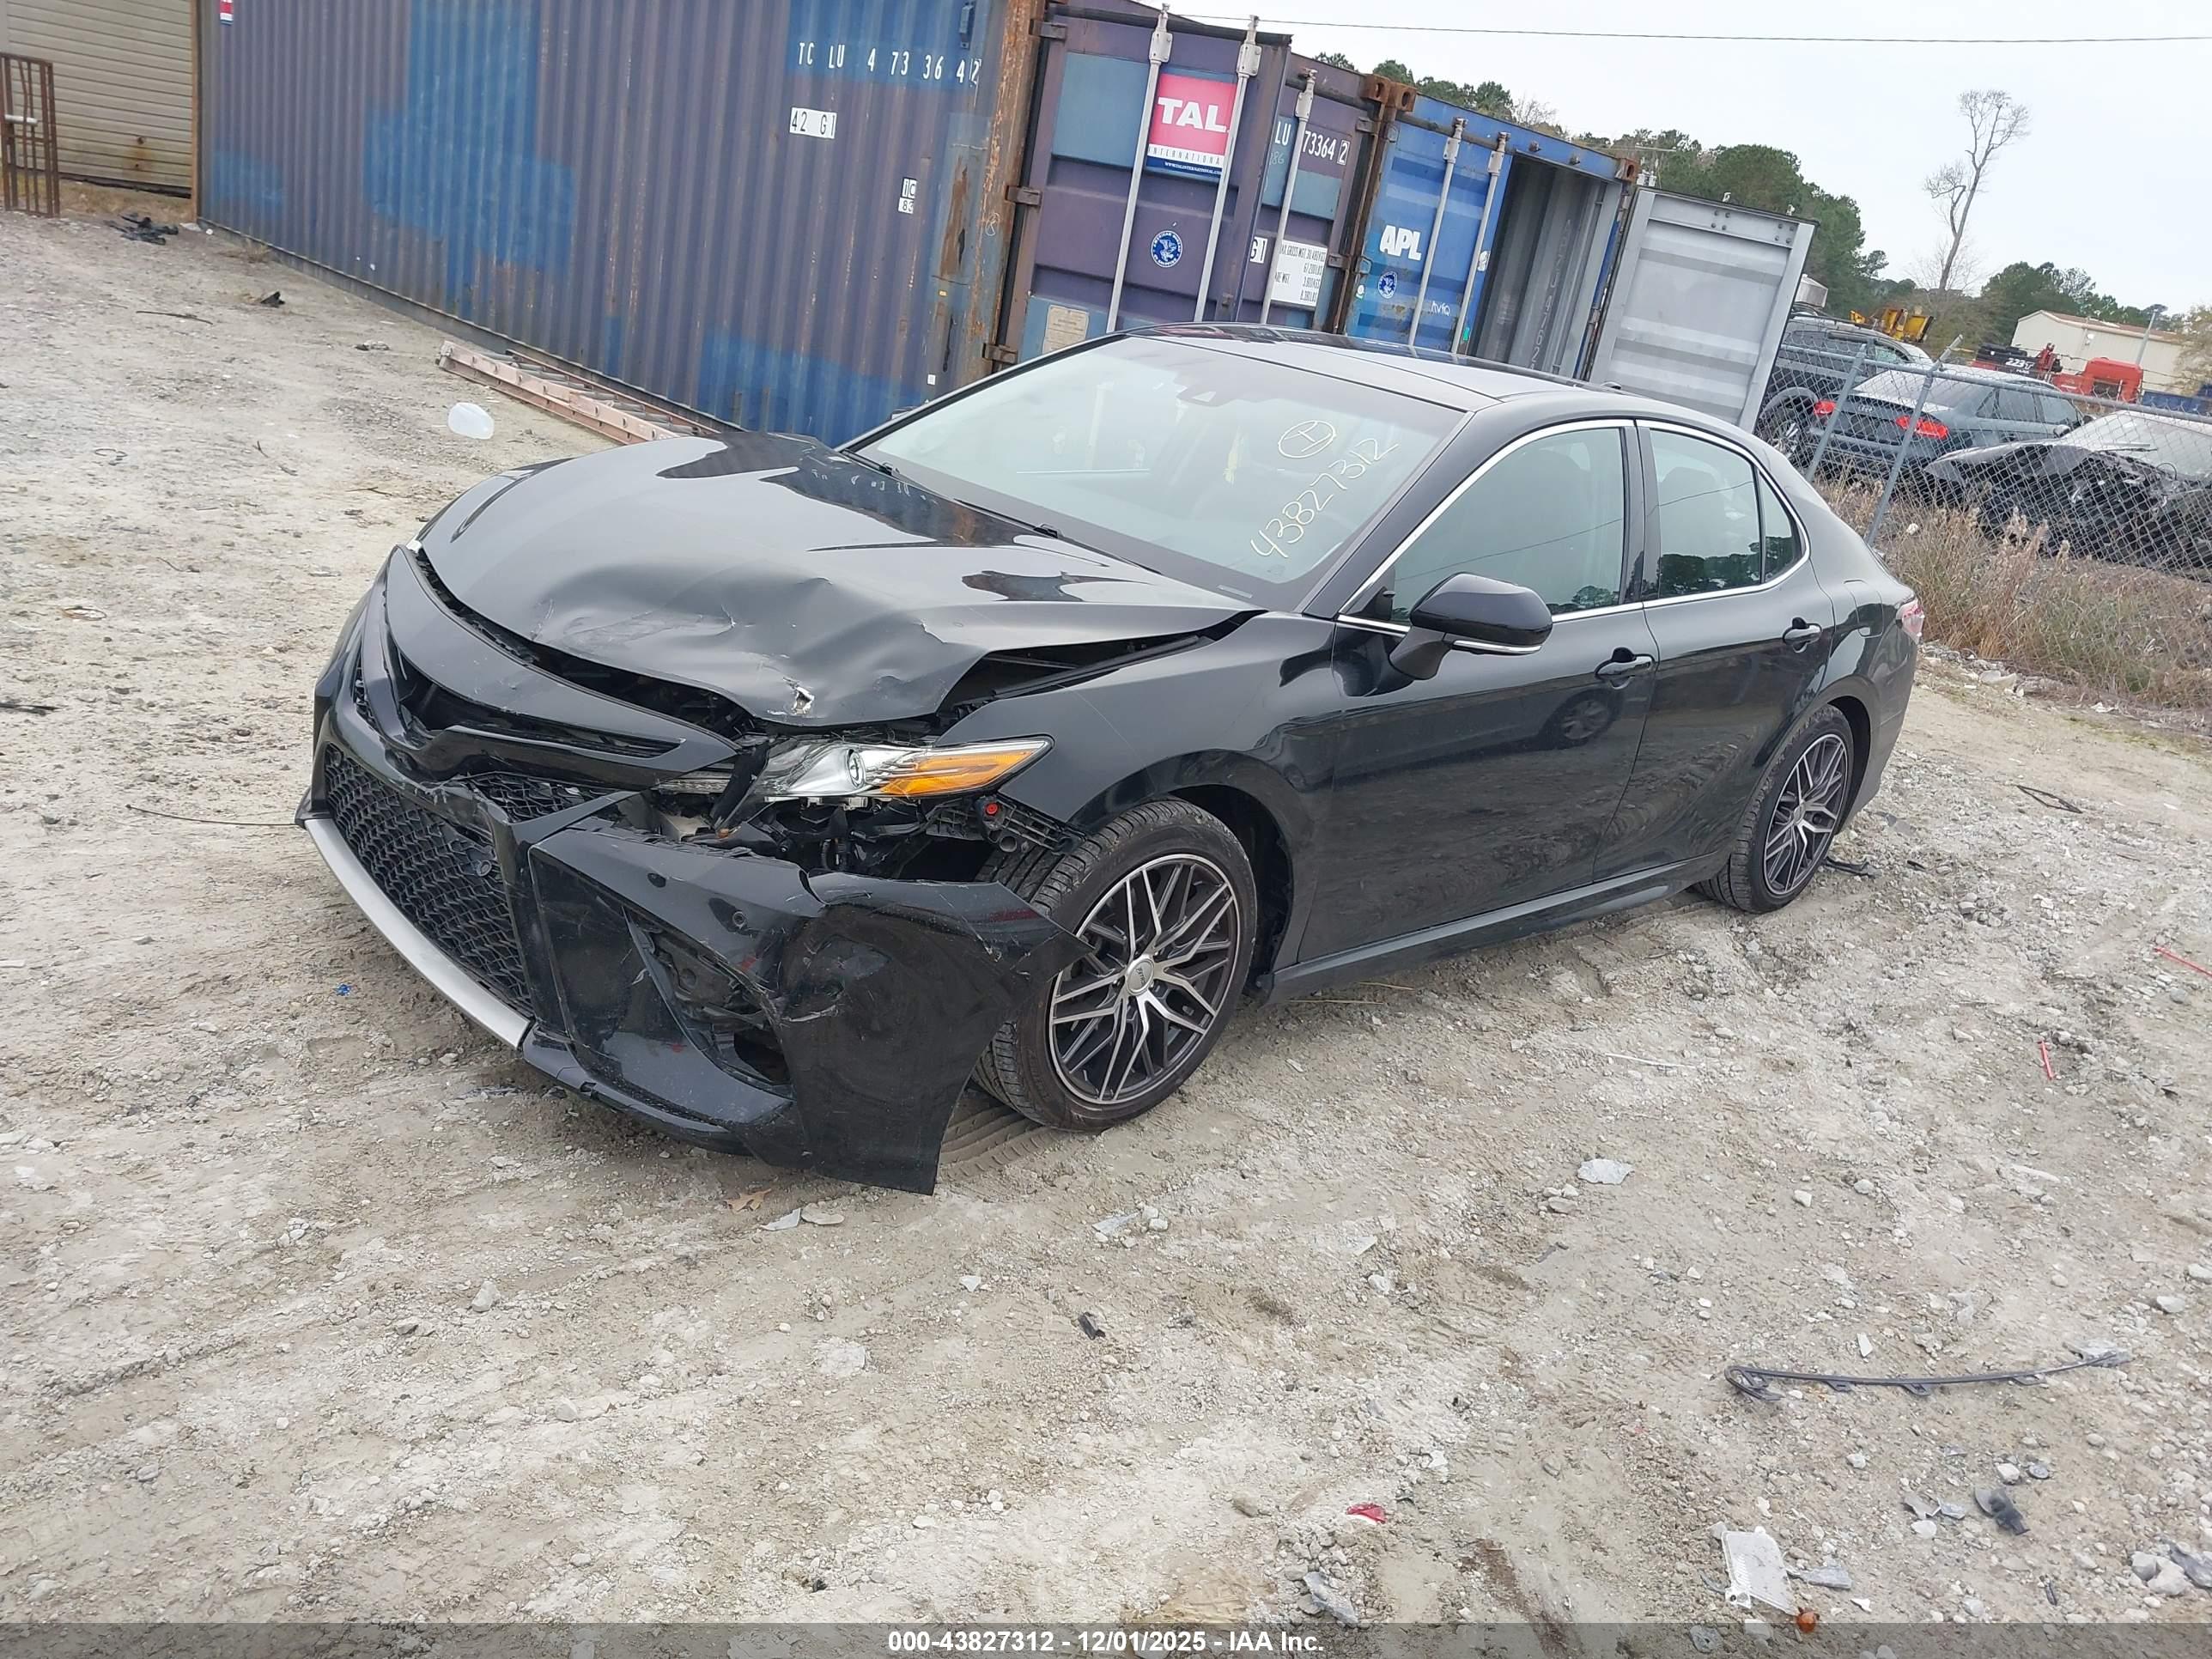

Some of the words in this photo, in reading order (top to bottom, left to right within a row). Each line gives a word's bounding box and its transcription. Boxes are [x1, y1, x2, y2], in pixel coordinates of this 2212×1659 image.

[1158, 96, 1227, 133] TAL
[1148, 147, 1220, 165] INTERNATIONA
[1302, 131, 1337, 161] 73364
[1379, 224, 1422, 262] APL
[1250, 438, 1399, 558] 43827312
